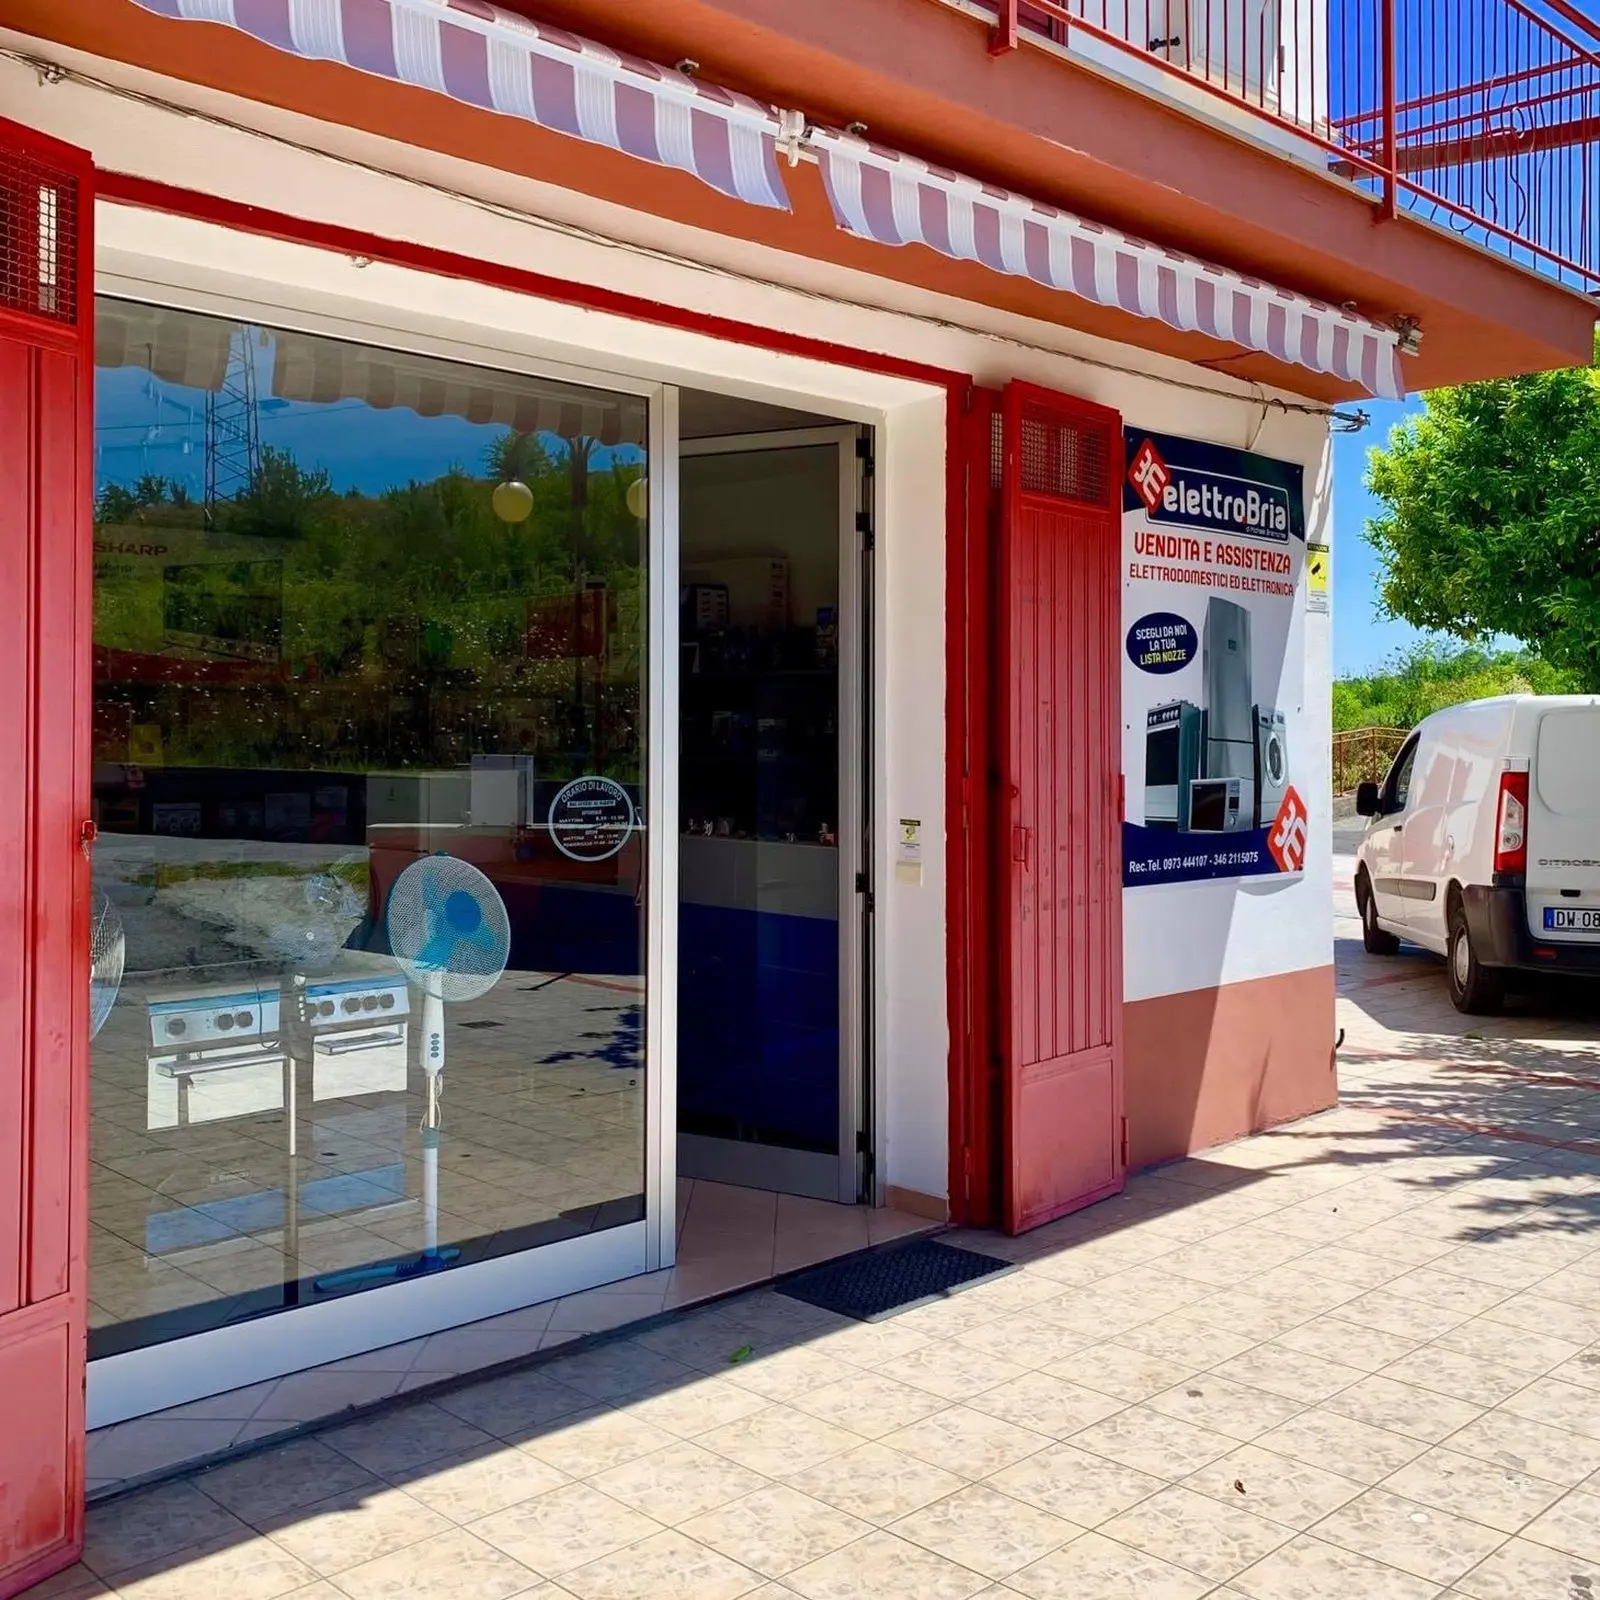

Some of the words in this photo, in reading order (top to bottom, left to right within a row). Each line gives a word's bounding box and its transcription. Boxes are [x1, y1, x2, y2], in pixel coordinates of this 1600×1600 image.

[1163, 480, 1286, 530] elettroBria
[93, 541, 168, 556] SHARP
[1134, 531, 1200, 561] VENDITA
[1204, 541, 1212, 563] E
[1216, 543, 1291, 575] ASSISTENZA
[1130, 563, 1228, 588] ELETTRODOMESTICI
[1230, 574, 1240, 589] ED
[1242, 576, 1294, 597] ELETTRONICA
[1136, 627, 1162, 640] SCEGLI
[1163, 626, 1174, 637] DA
[1174, 624, 1187, 636] NOI
[1149, 640, 1160, 651] LA
[1160, 638, 1176, 650] TUA
[1140, 652, 1161, 665] LISTA
[1162, 649, 1186, 662] NOZZE
[561, 782, 587, 803] ORARIO
[589, 781, 596, 790] DI
[596, 782, 623, 801] LAVORO
[1163, 857, 1181, 870] 0973
[1182, 855, 1208, 868] 444107
[1213, 854, 1227, 866] 346
[1228, 851, 1259, 864] 2115075
[1556, 911, 1576, 926] DW
